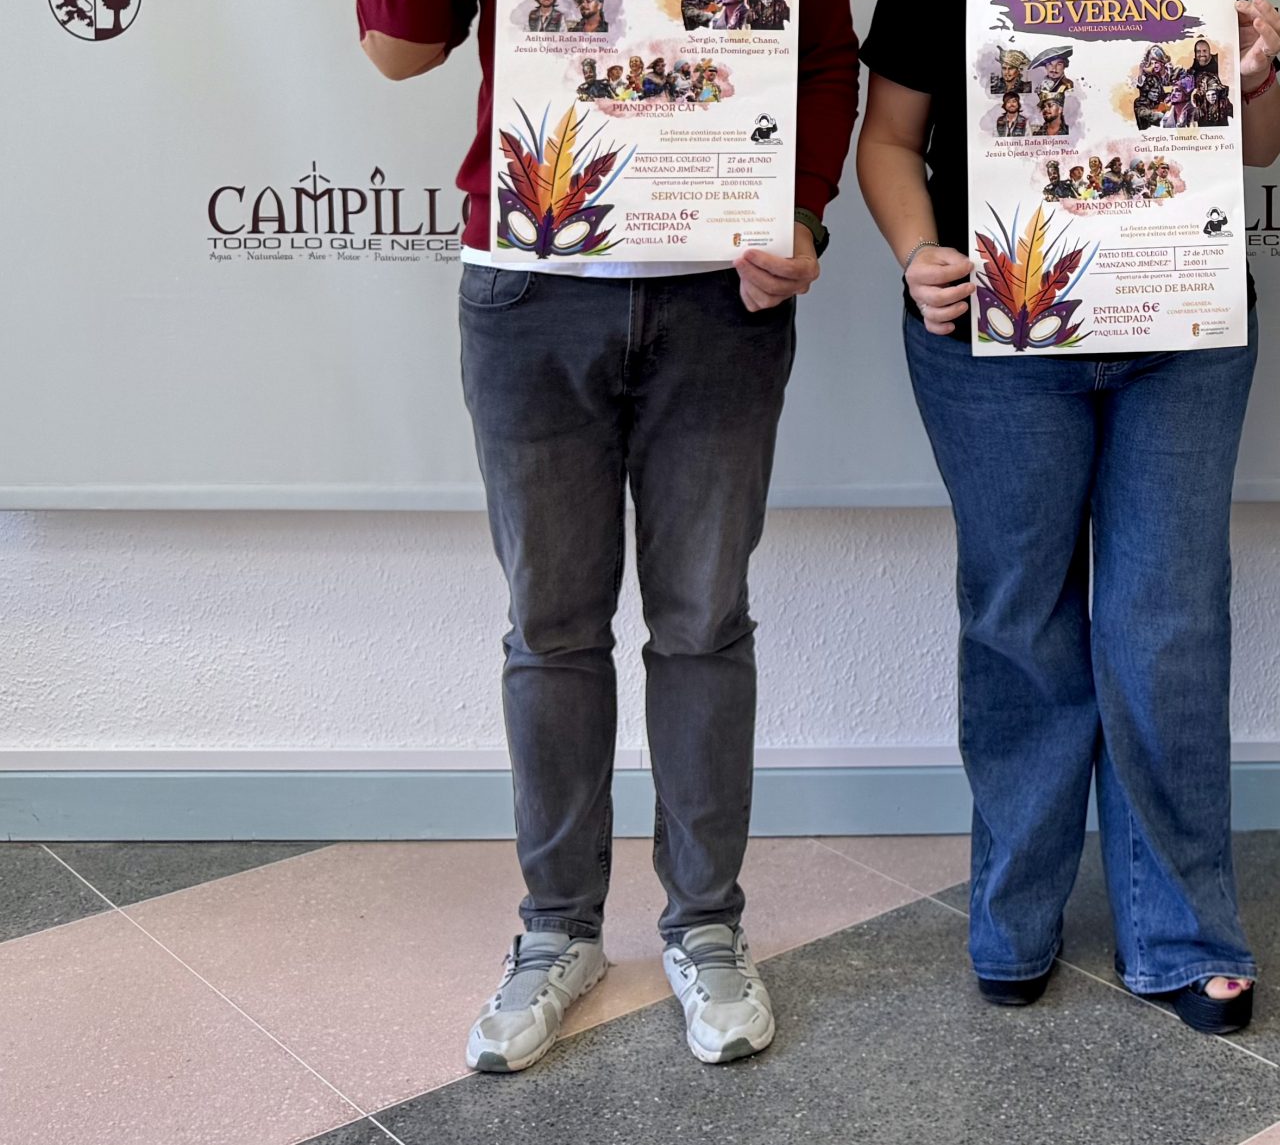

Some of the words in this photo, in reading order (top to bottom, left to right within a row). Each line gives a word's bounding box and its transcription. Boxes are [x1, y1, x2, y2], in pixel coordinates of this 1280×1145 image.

[1024, 1, 1063, 23] DE
[613, 103, 652, 111] PIANDO
[655, 103, 675, 111] POR
[208, 160, 470, 235] CAMPILL
[651, 191, 702, 200] SERVICIO
[705, 191, 720, 199] DE
[722, 191, 759, 199] BARRA
[1076, 201, 1112, 210] PIANDO
[1114, 200, 1133, 208] POR
[625, 212, 676, 220] ENTRADA
[679, 209, 699, 220] 6€
[625, 222, 691, 230] ANTICIPADA
[207, 237, 281, 249] TODO
[291, 237, 322, 249] LO
[330, 238, 382, 250] QUE
[625, 236, 663, 244] TAQUILLA
[667, 235, 687, 243] 10€
[209, 251, 232, 262] Agua
[247, 251, 293, 261] Naturaleza
[337, 252, 360, 261] Motor
[374, 252, 420, 261] Patrimonio
[434, 252, 460, 264] Depor
[1135, 249, 1168, 257] COLEGIO
[1115, 284, 1162, 294] SERVICIO
[1164, 284, 1178, 292] DE
[1179, 282, 1214, 291] BARRA
[1093, 305, 1139, 314] ENTRADA
[1142, 301, 1160, 312] 6€
[1093, 314, 1153, 324] ANTICIPADA
[1093, 328, 1128, 336] TAQUILLA
[1131, 326, 1150, 335] 10€
